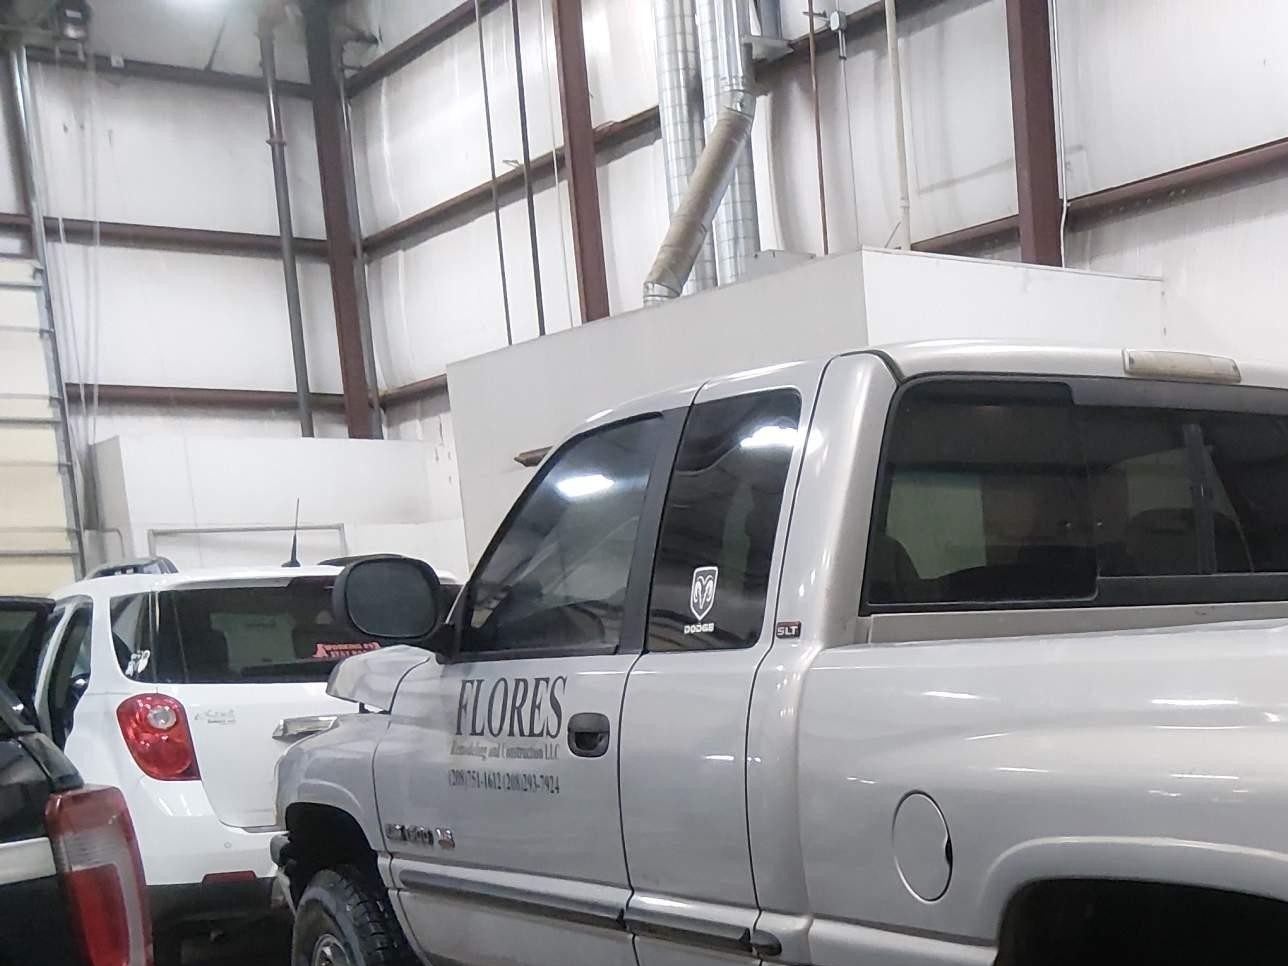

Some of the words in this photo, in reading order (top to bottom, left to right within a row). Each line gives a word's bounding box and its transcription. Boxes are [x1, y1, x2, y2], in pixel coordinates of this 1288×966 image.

[683, 622, 715, 635] DODGE
[776, 625, 799, 636] SLT
[455, 675, 568, 739] FLORES
